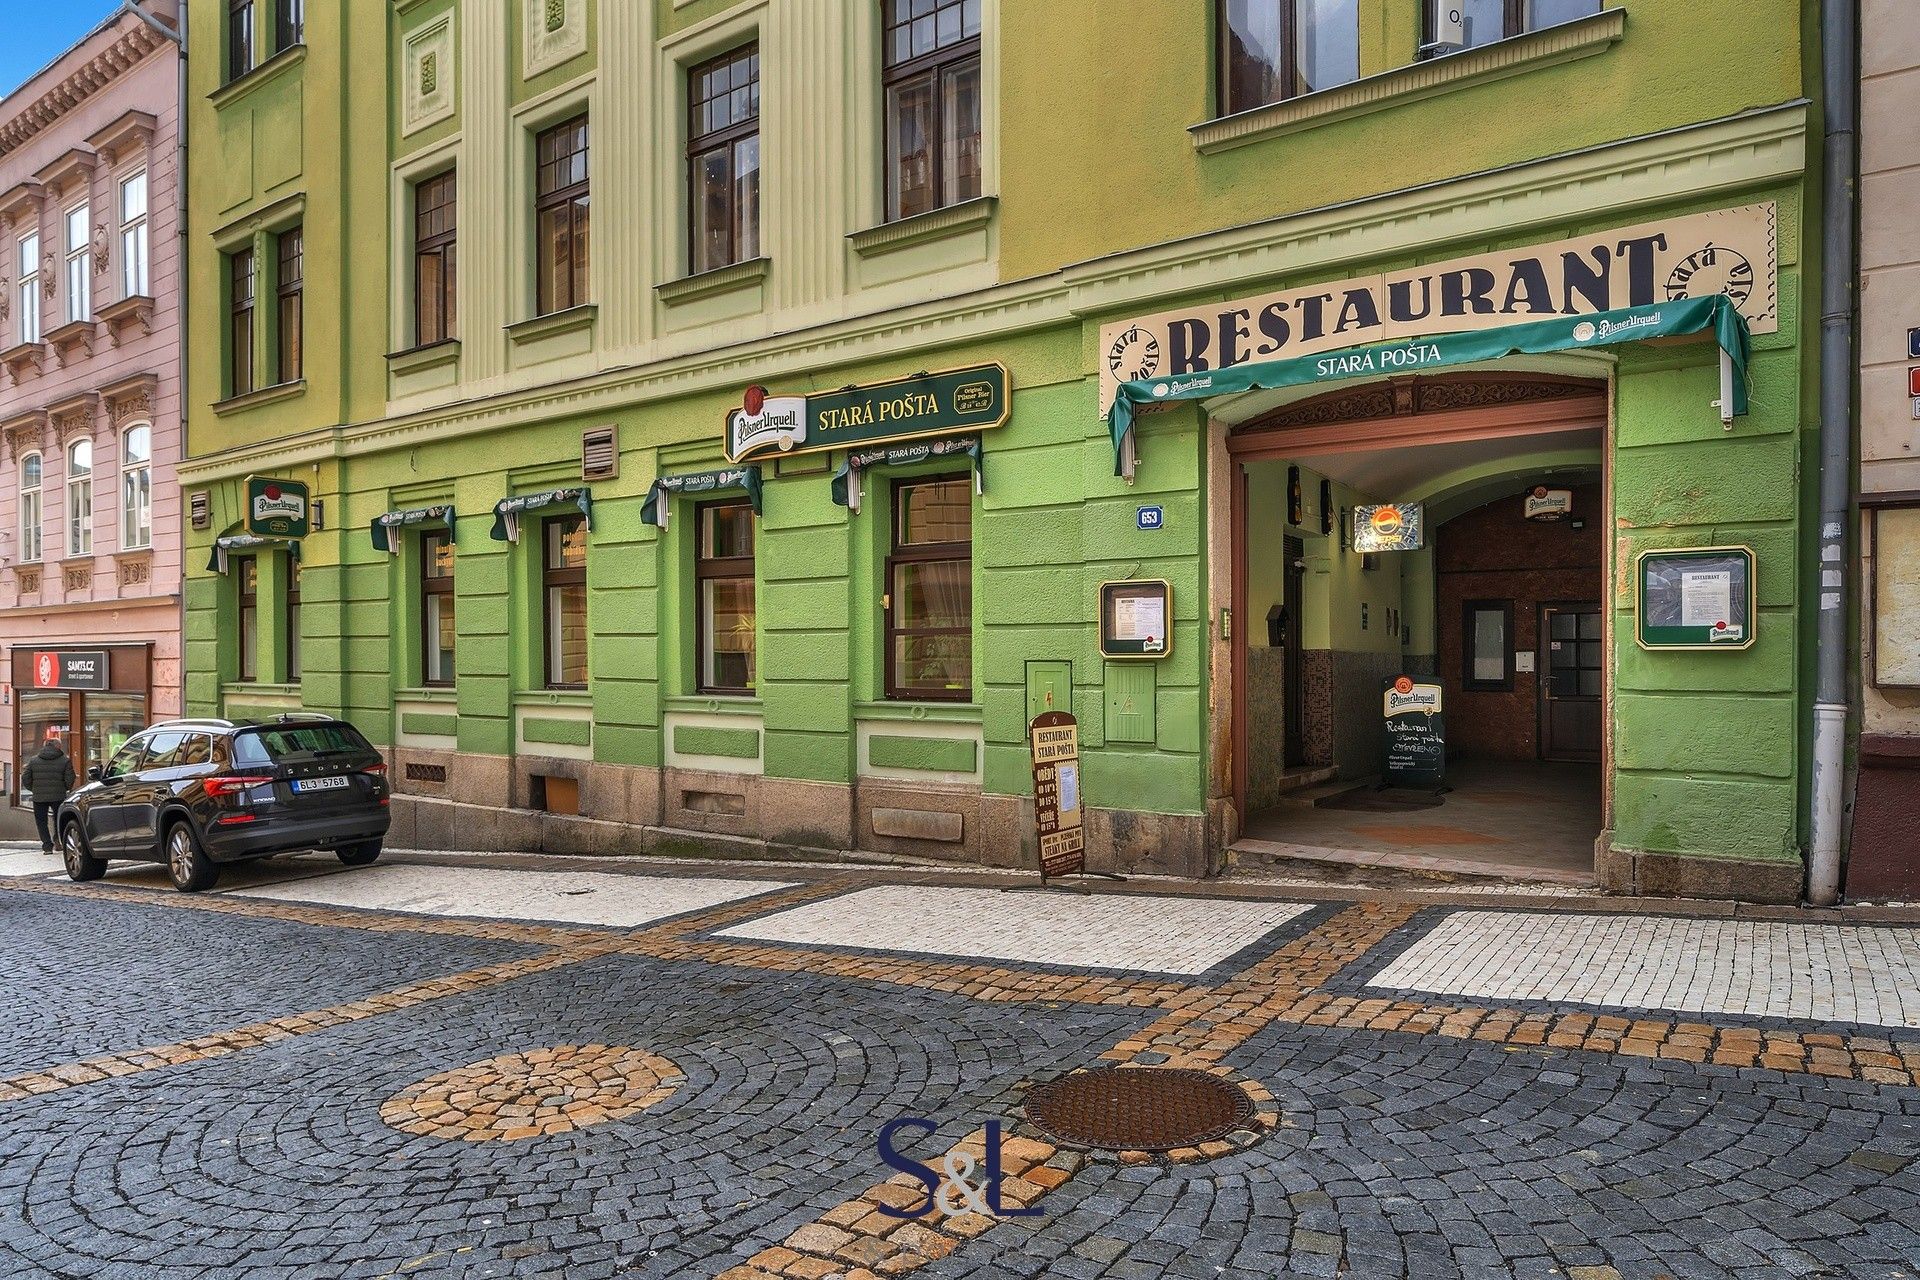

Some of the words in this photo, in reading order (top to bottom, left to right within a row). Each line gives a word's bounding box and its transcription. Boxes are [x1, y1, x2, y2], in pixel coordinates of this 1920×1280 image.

[1167, 231, 1668, 376] RESTAURANT
[1108, 324, 1138, 370] stará
[1316, 350, 1375, 376] STARÁ
[1380, 342, 1442, 368] POŠTA
[819, 399, 875, 431] STARÁ
[878, 392, 940, 421] POŠTA
[738, 417, 764, 446] Pilsner
[763, 410, 798, 433] Urquell
[888, 448, 909, 459] STARÁ
[909, 445, 930, 457] POŠTA
[1141, 511, 1158, 524] 653
[1390, 693, 1414, 708] Pilsner
[1412, 694, 1436, 705] Urquell
[1038, 729, 1073, 744] RESTAURANT
[1037, 744, 1056, 758] STARÁ
[1056, 743, 1075, 756] POŠTA
[300, 780, 318, 790] 6L3
[322, 777, 345, 787] 5768
